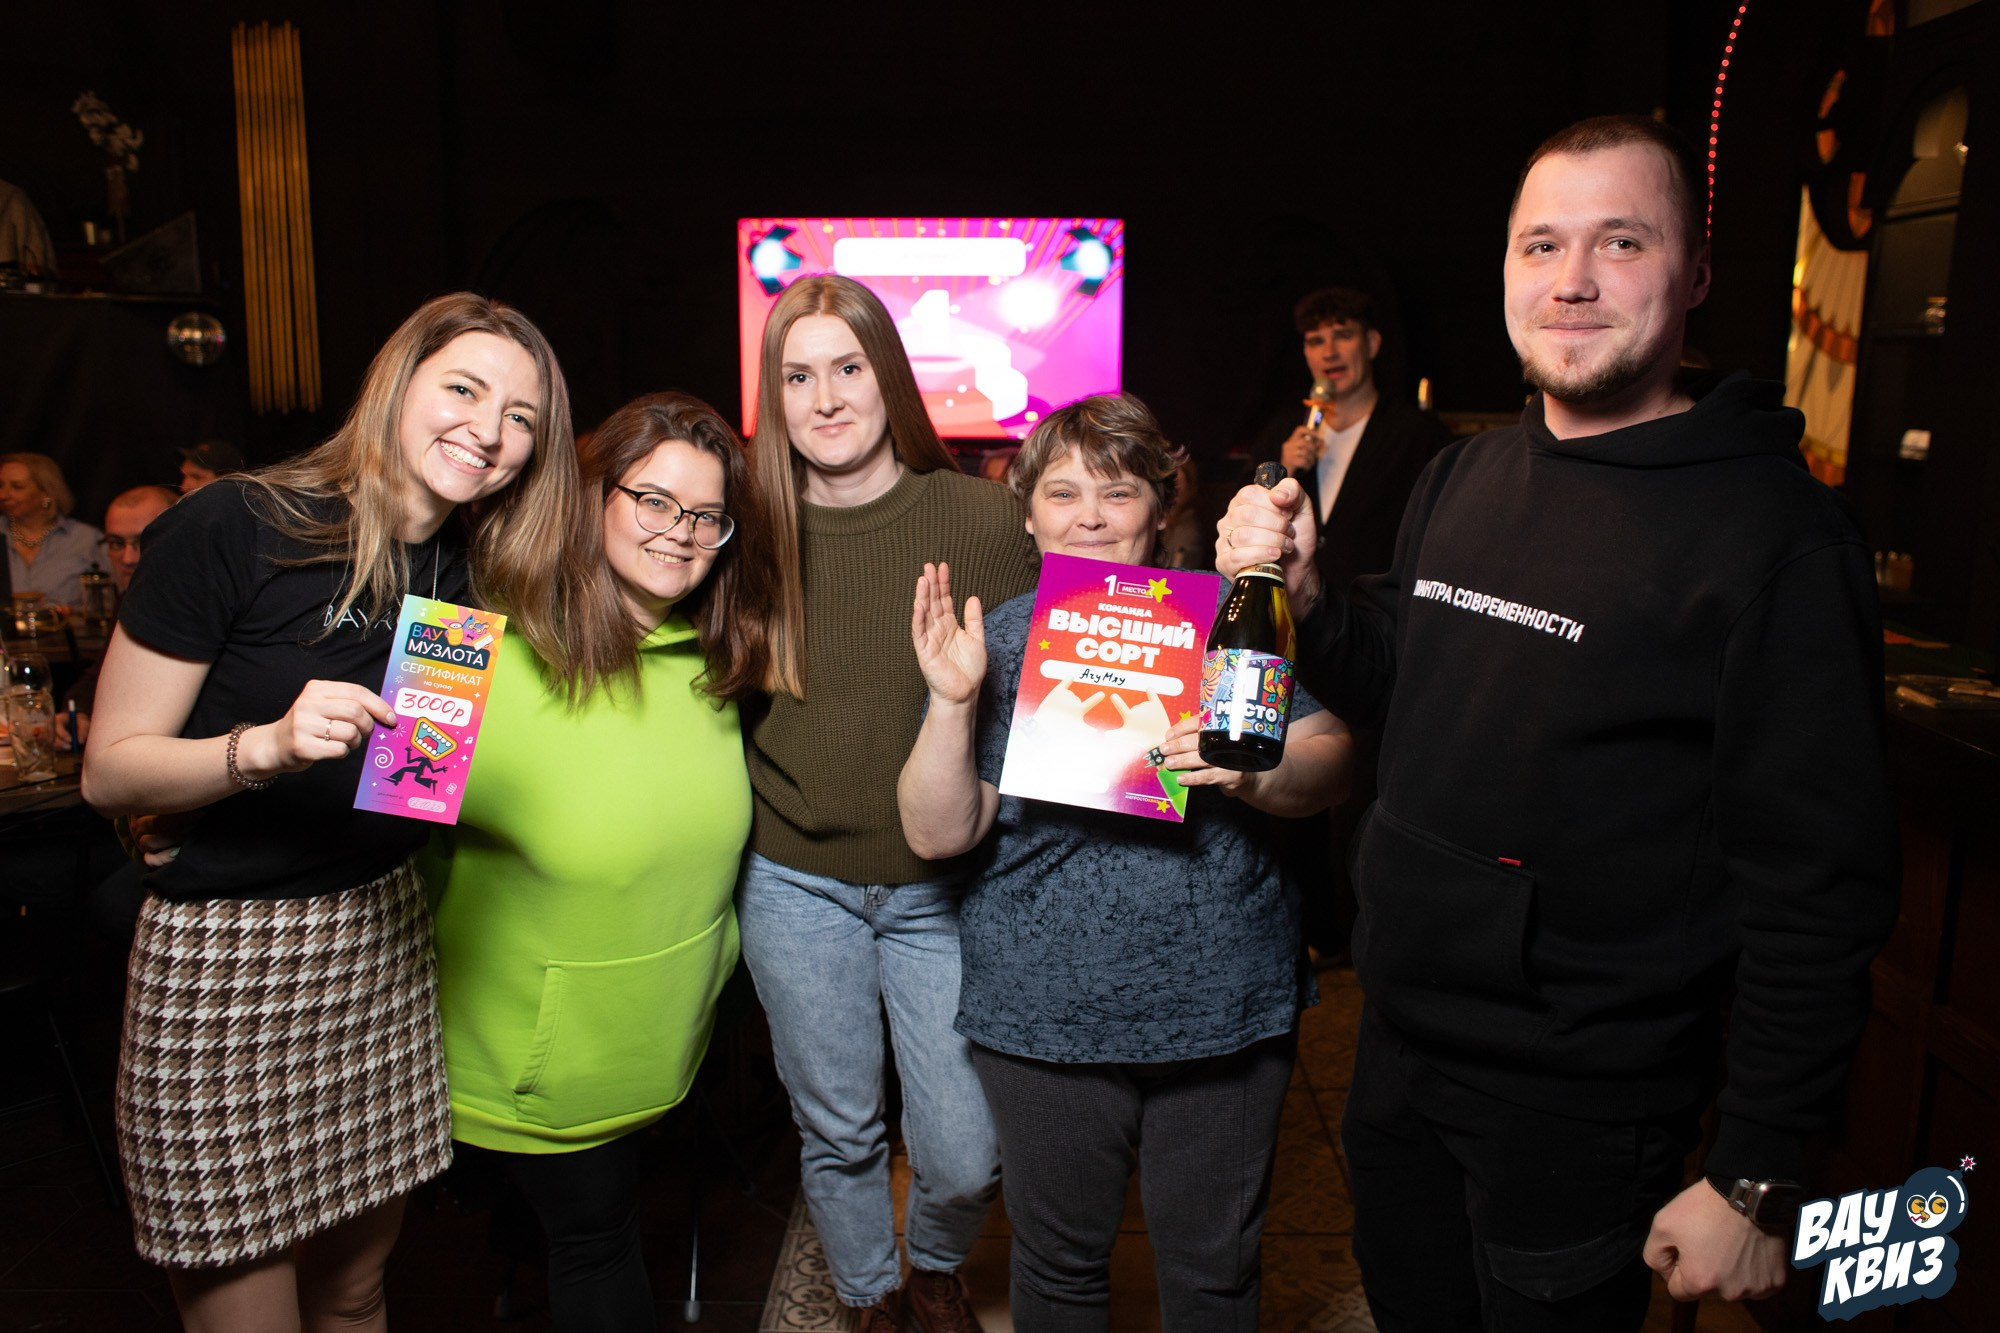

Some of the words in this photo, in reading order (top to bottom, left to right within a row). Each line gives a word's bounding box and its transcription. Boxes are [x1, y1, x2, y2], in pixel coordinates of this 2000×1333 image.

[1104, 574, 1117, 597] 1
[1122, 586, 1147, 594] МЕСТО
[1098, 602, 1153, 618] КОМАНДА
[1452, 588, 1585, 643] СОВРЕМЕННОСТИ
[412, 624, 443, 641] ВАУ
[1048, 608, 1196, 650] ВЫСШИЙ
[408, 639, 484, 666] МУЗЛОТА
[1075, 637, 1160, 668] СОРТ
[400, 661, 484, 686] СЕРТИФИКАТ
[1216, 701, 1278, 722] МСТО
